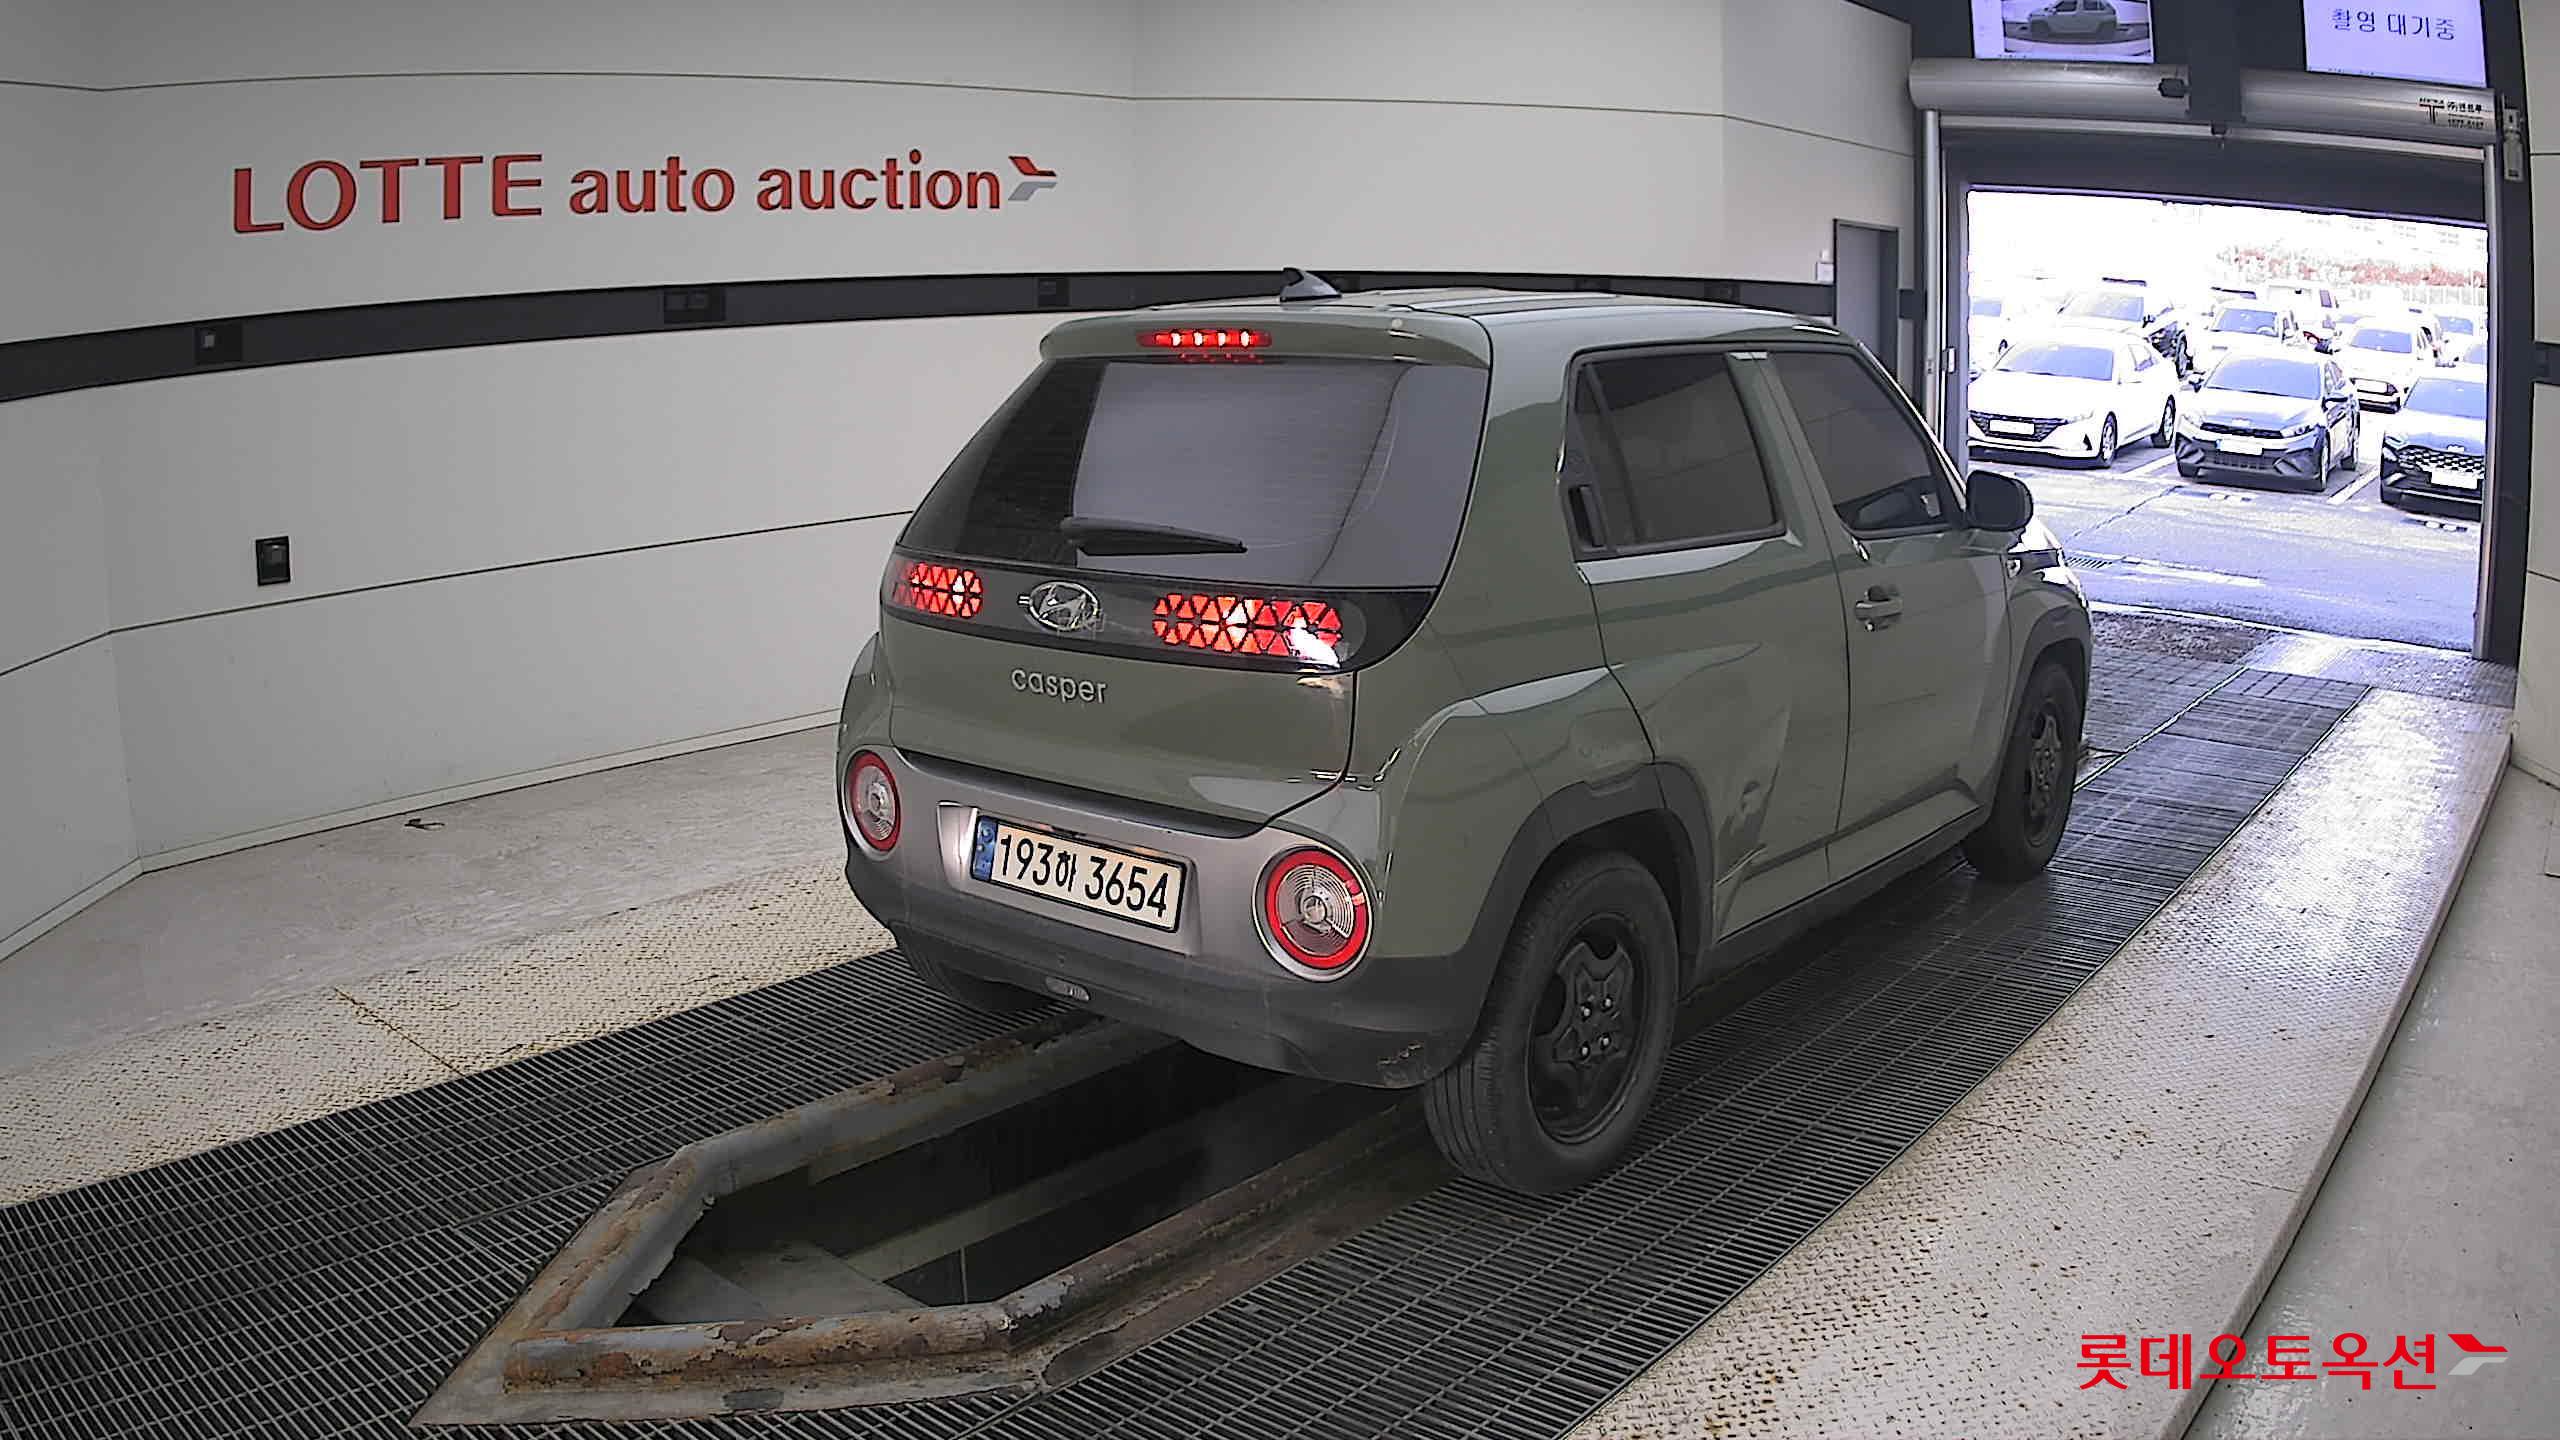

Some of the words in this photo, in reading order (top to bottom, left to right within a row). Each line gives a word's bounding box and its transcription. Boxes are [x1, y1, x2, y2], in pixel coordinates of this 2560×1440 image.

[2332, 9, 2376, 33] 촬영
[2387, 13, 2456, 40] 대기중
[233, 153, 543, 234] LOTTE
[568, 155, 736, 214] auto
[756, 149, 1001, 211] auction
[1010, 667, 1107, 704] casper
[1000, 834, 1077, 892] 193하
[1085, 854, 1170, 918] 3654
